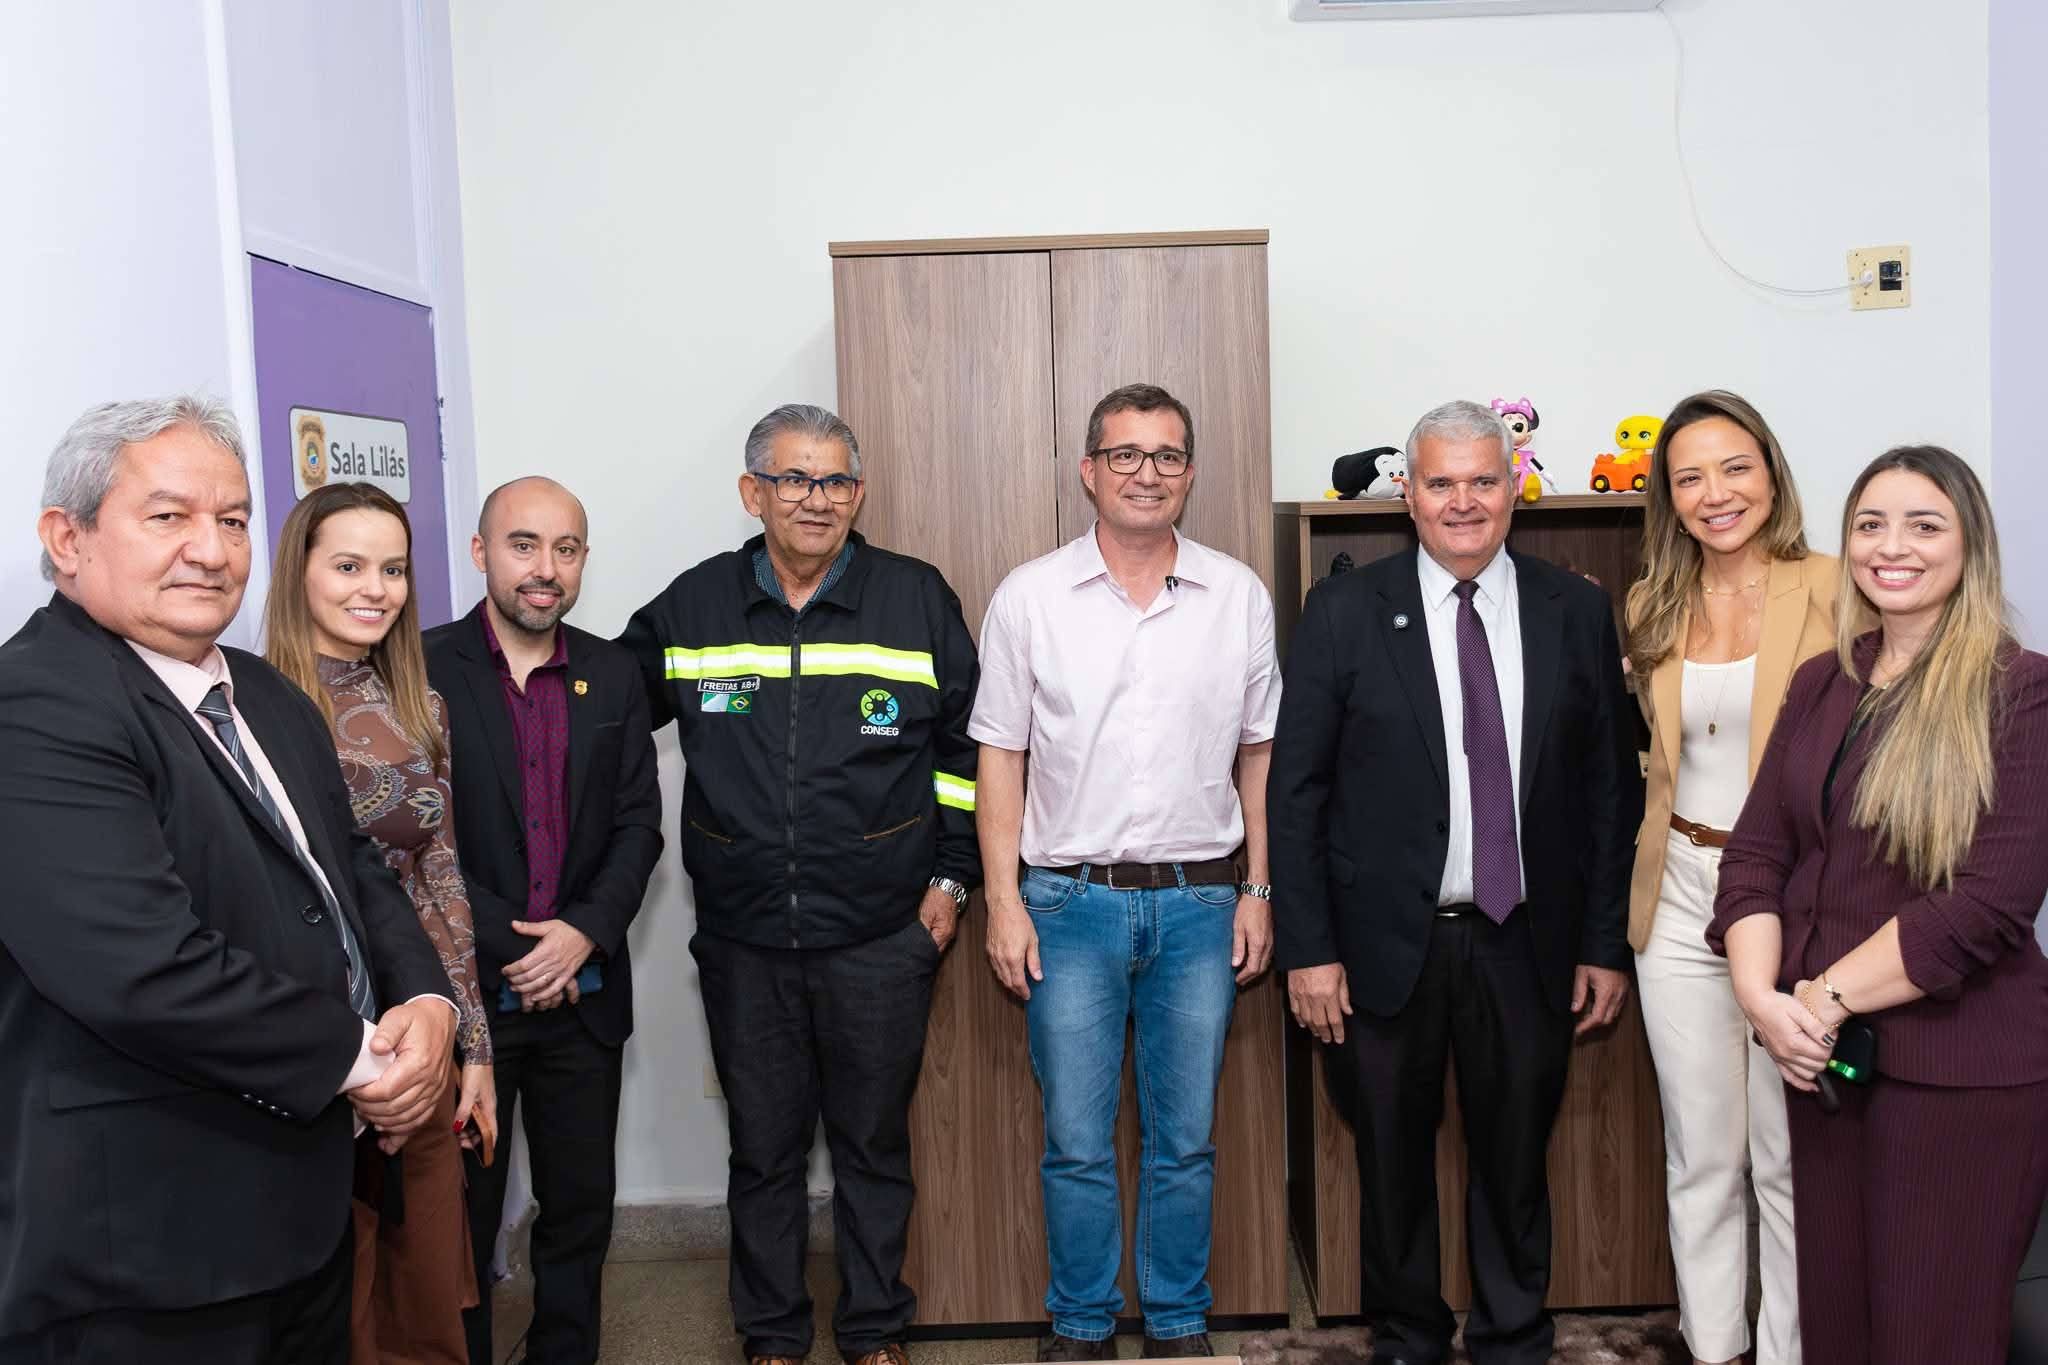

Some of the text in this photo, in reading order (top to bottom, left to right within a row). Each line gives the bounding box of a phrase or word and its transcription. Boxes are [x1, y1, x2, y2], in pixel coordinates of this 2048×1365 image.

[330, 441, 406, 479] Sala Lilás
[703, 681, 738, 691] FREITAS
[860, 725, 900, 736] CONSEG
